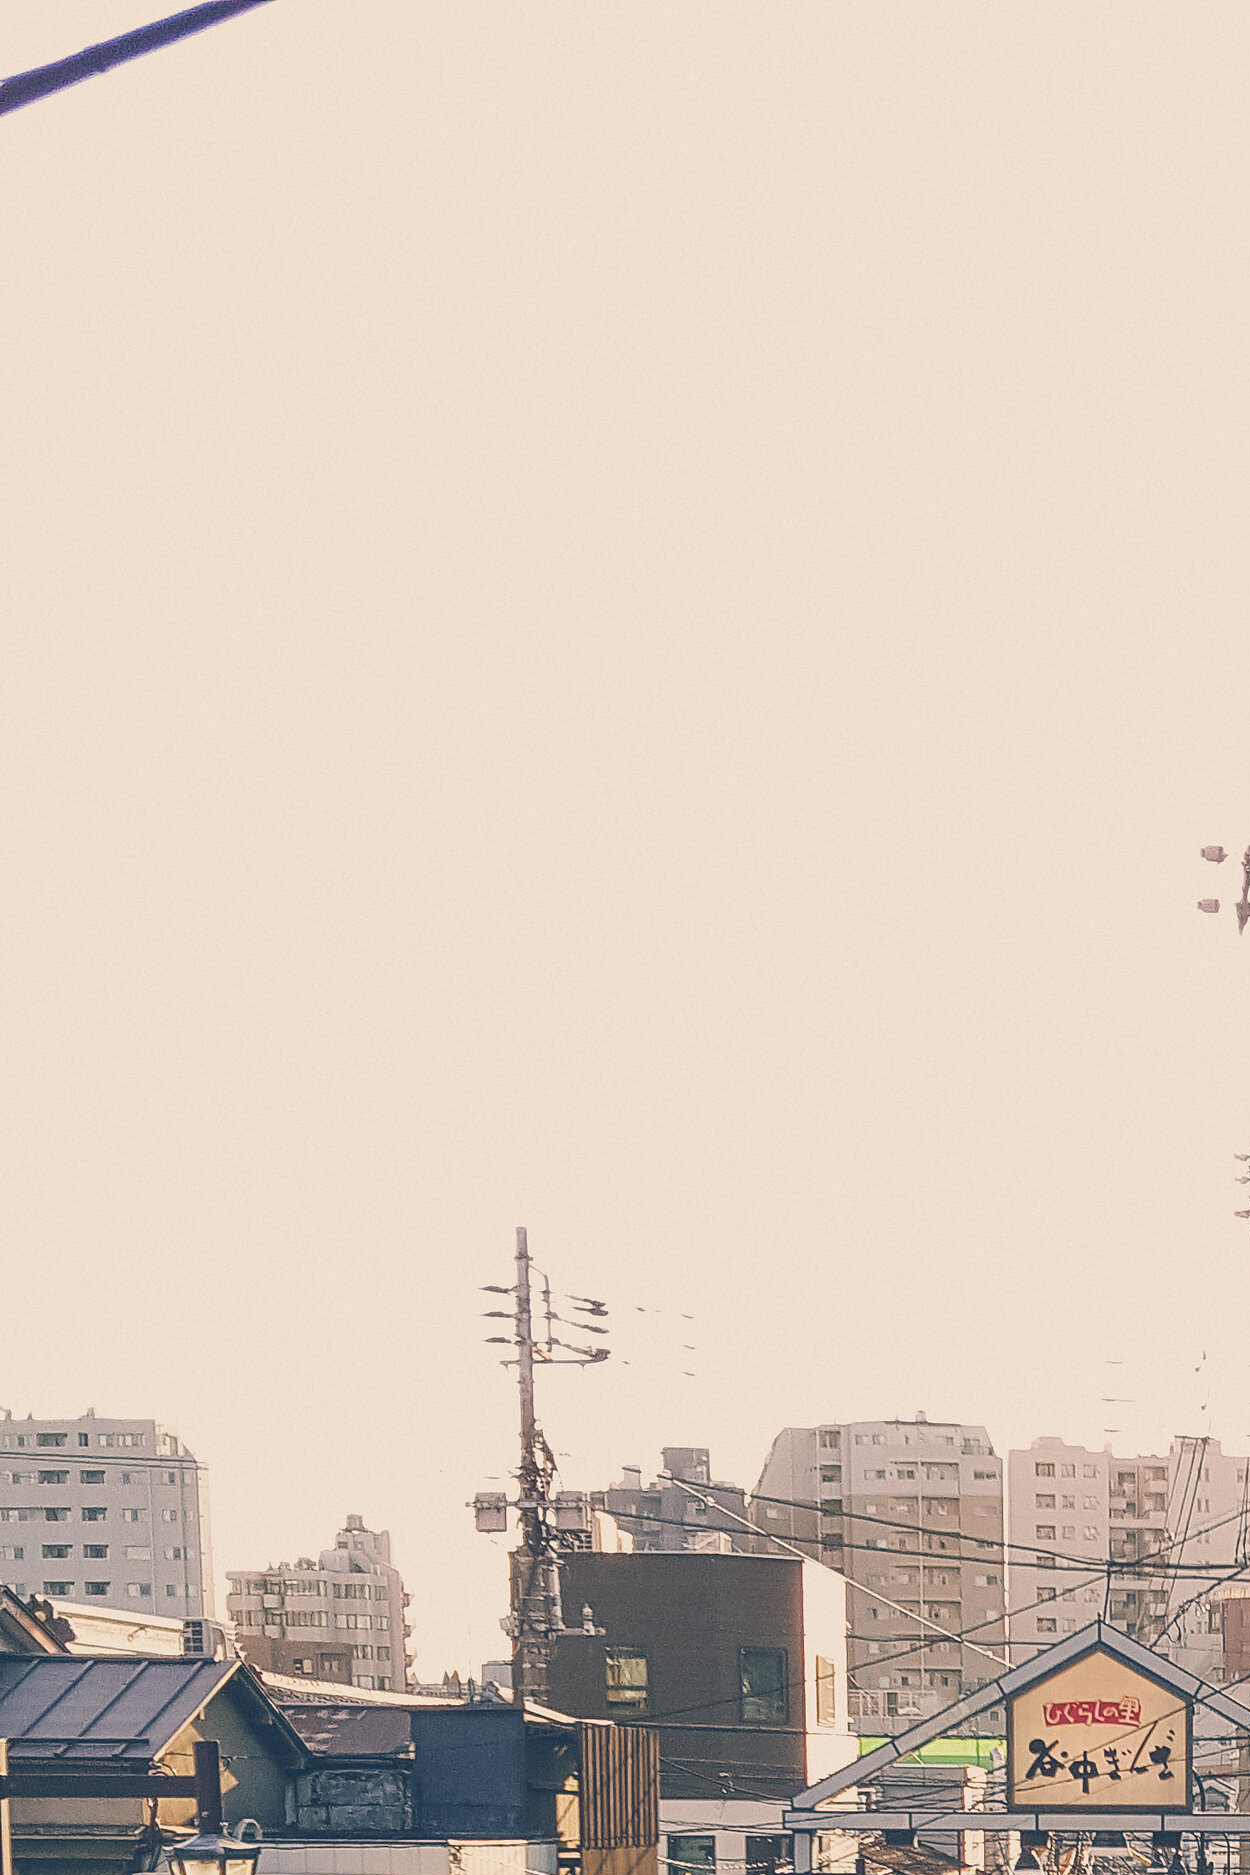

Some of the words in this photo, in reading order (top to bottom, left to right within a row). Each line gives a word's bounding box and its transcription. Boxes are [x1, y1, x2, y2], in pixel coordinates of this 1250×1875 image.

[1045, 1696, 1141, 1726] ひぐらしの里
[1025, 1720, 1176, 1794] 谷中ぎんざ
